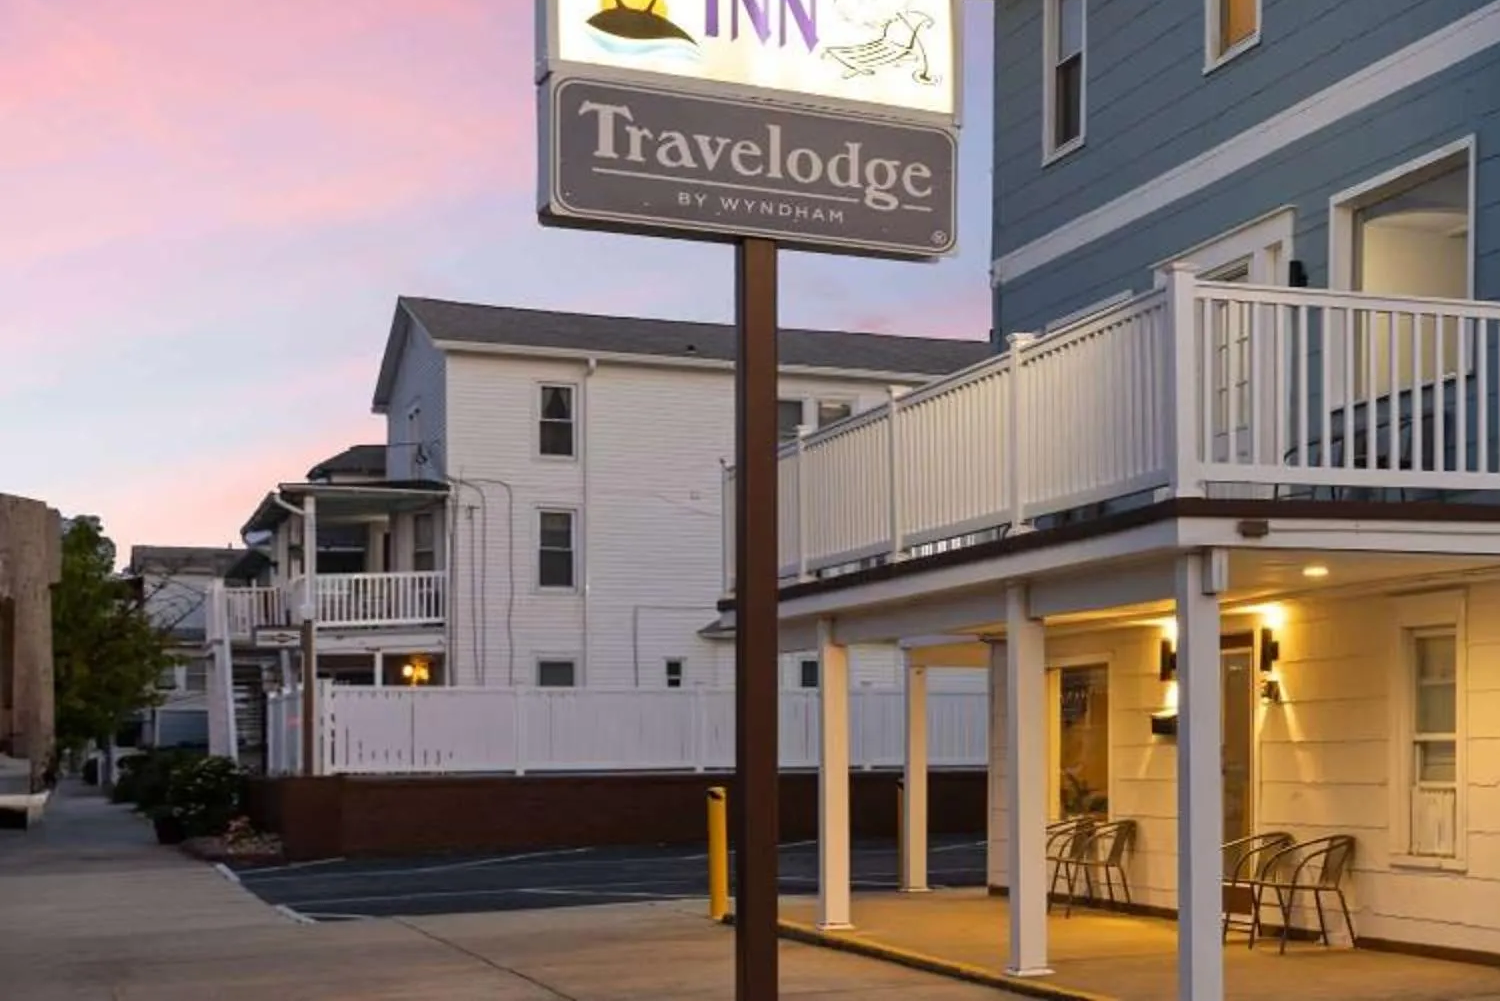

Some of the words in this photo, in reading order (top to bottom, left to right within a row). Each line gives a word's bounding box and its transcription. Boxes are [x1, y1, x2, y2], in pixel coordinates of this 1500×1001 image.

[578, 100, 932, 211] Travelodge
[677, 191, 707, 208] BY
[720, 196, 845, 224] WYNDHAM
